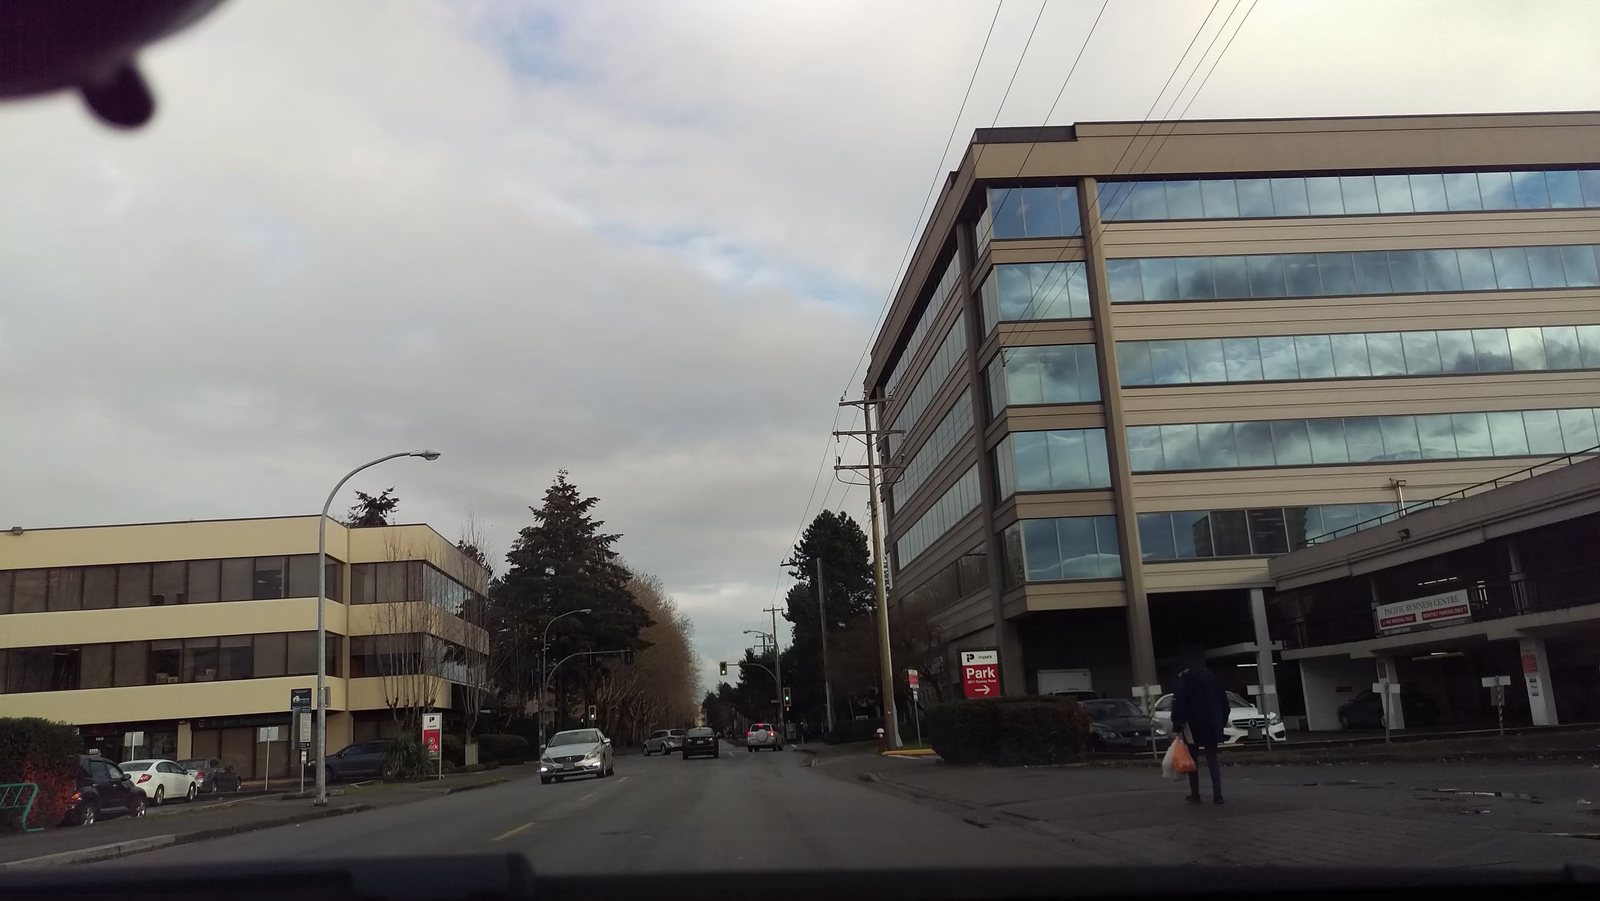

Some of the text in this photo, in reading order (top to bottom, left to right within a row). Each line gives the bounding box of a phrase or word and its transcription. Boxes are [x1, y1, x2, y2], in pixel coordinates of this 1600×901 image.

[1406, 600, 1432, 611] BUSINESS
[1433, 595, 1458, 606] CENTRE
[1439, 608, 1454, 616] PARKING
[966, 667, 996, 679] Park
